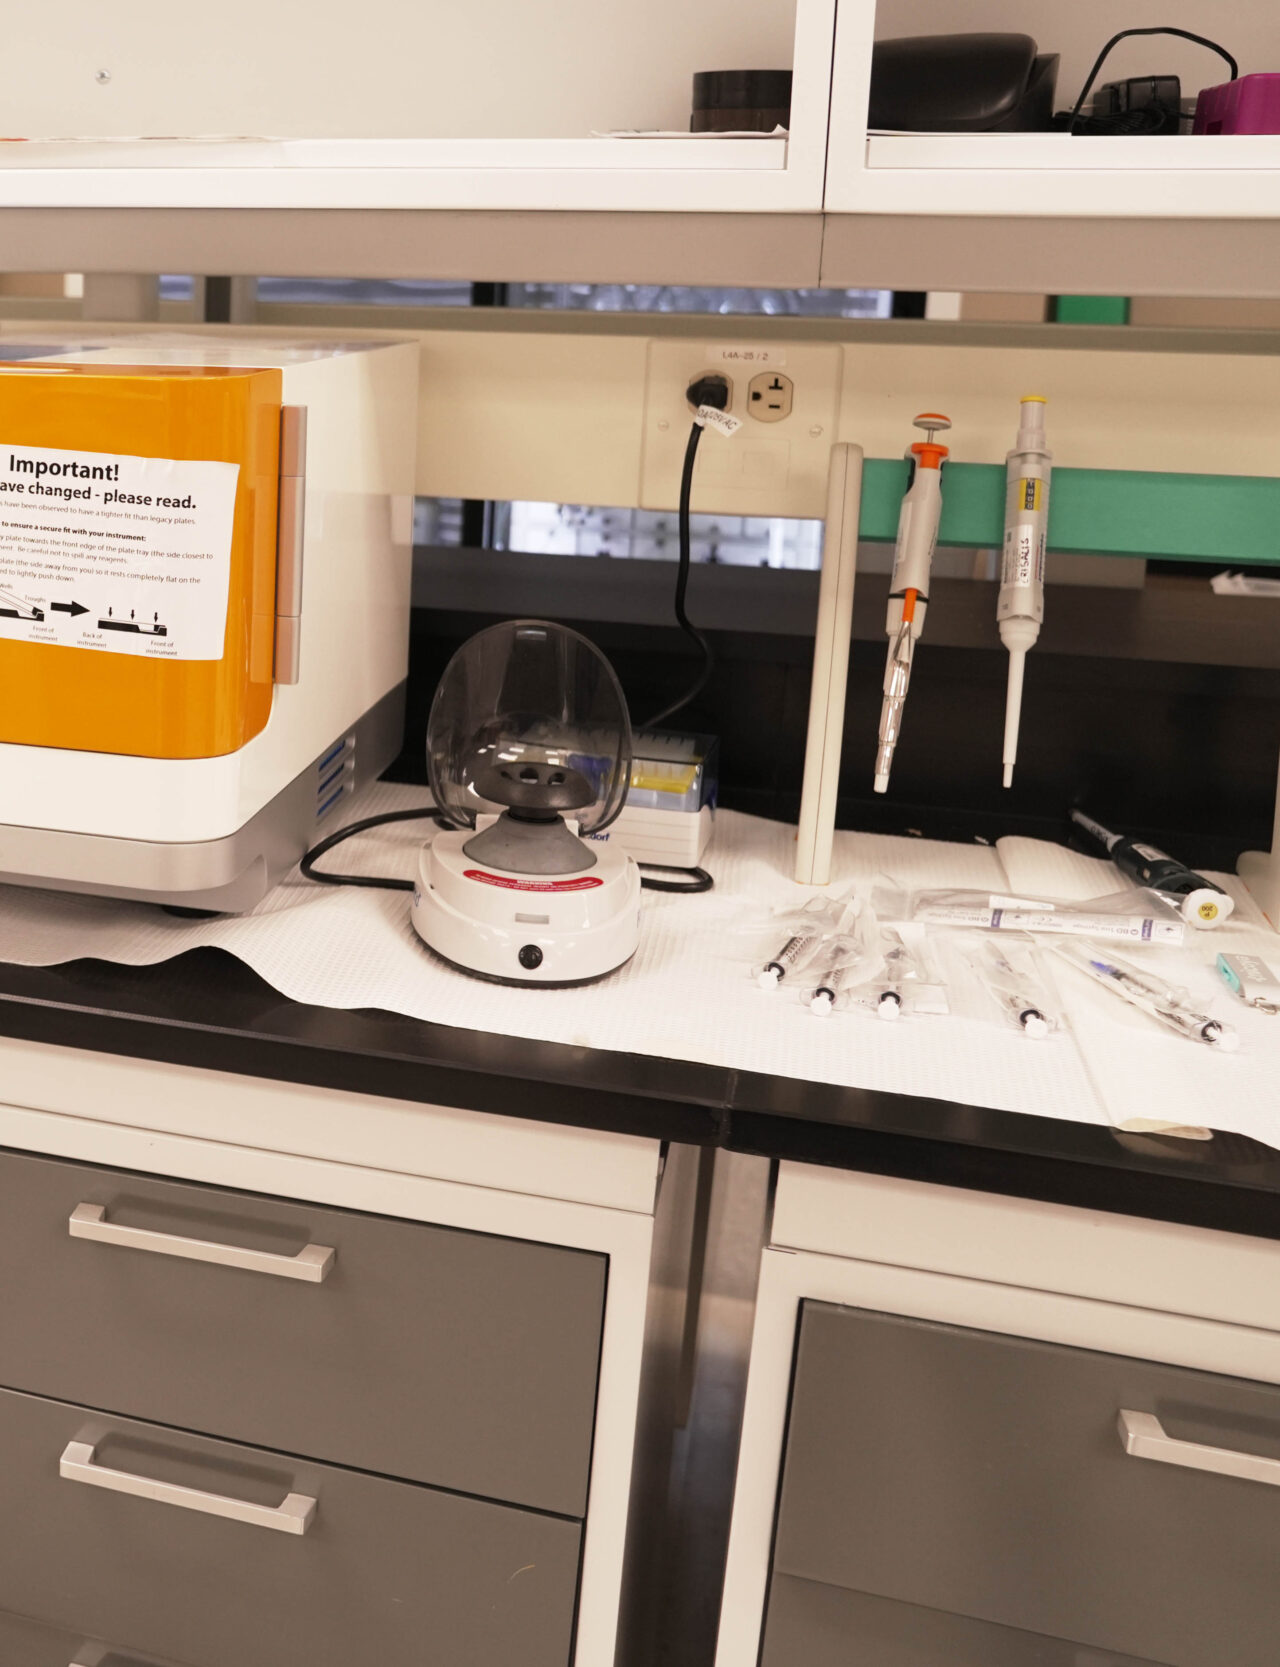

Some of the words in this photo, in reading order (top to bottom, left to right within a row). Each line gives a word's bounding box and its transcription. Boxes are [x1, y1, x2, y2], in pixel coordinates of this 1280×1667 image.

[10, 455, 119, 481] Important!
[29, 482, 91, 500] changed
[104, 490, 152, 506] please
[156, 496, 196, 509] read.
[39, 504, 68, 513] observed
[79, 508, 94, 516] have
[101, 511, 123, 519] tighter
[150, 515, 171, 524] legacy
[23, 536, 49, 545] towards
[80, 543, 96, 551] edge
[118, 546, 134, 554] plate
[137, 548, 149, 557] tray
[106, 532, 146, 542] instrument:
[26, 546, 48, 555] careful
[0, 557, 14, 566] plate
[127, 572, 164, 582] completely
[17, 570, 36, 578] lightly
